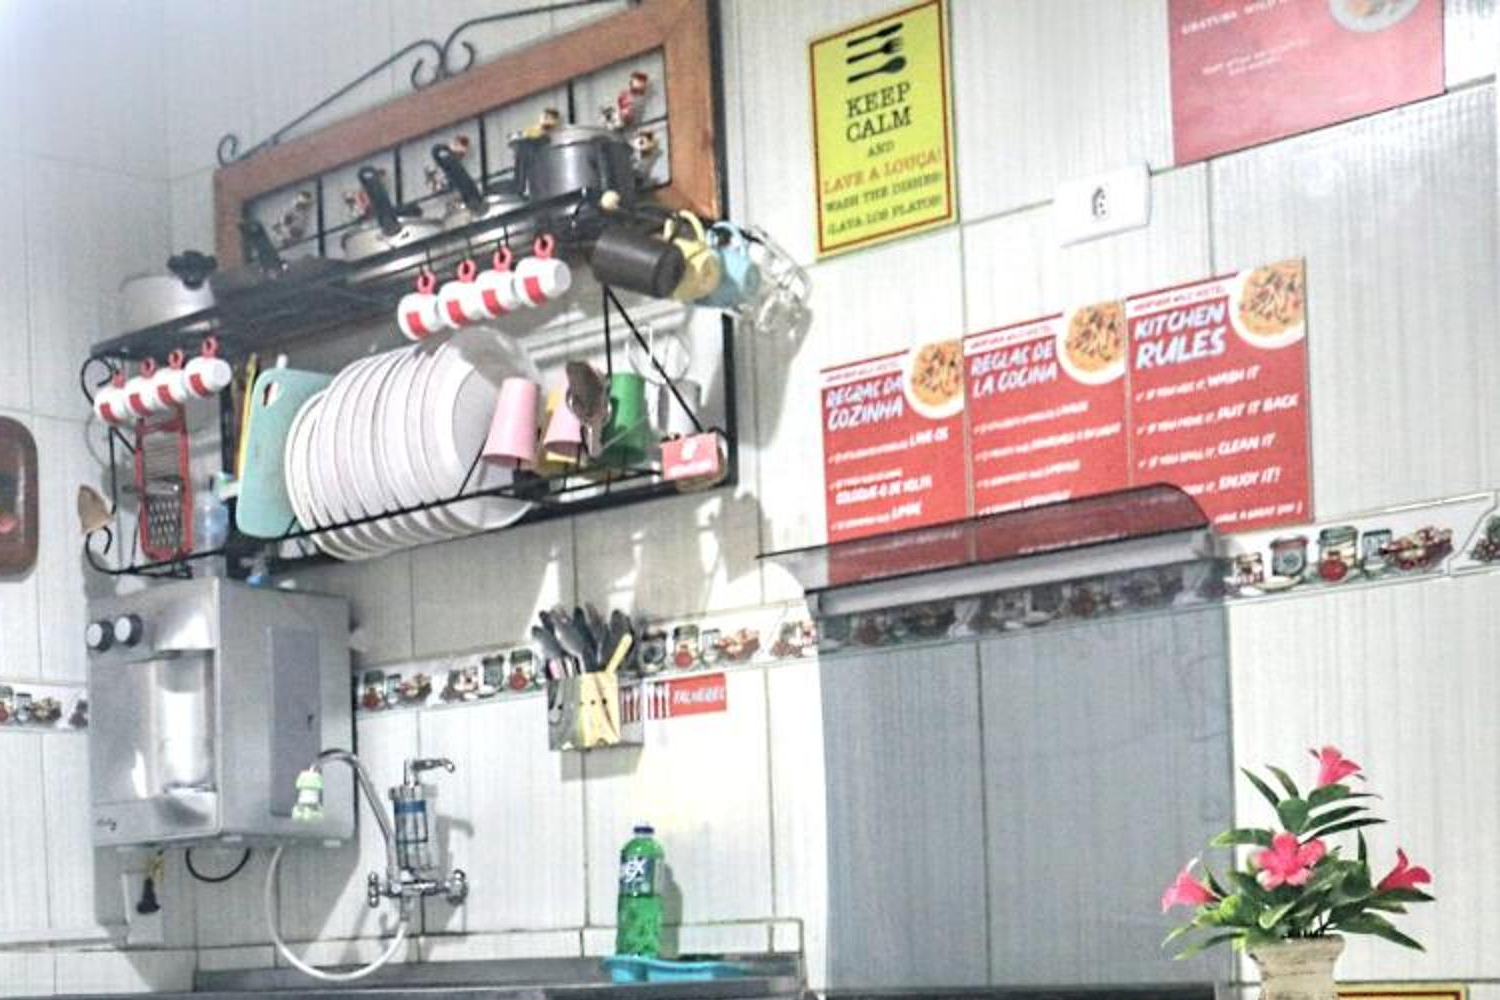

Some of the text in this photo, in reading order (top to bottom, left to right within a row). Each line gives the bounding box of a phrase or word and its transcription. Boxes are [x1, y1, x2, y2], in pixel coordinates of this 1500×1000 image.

[846, 81, 911, 118] KEEP
[846, 105, 912, 142] CALM
[868, 141, 895, 157] AND
[824, 170, 865, 194] LAVE
[869, 166, 880, 180] A
[825, 195, 859, 212] WASH
[863, 187, 888, 202] THE
[866, 208, 889, 223] LOS
[1135, 302, 1226, 341] KITCHEN
[1032, 339, 1054, 361] DE
[1136, 326, 1227, 370] RULES
[882, 375, 904, 396] DA
[973, 361, 1058, 400] LA COCINA
[1207, 369, 1245, 388] WASH
[1247, 365, 1261, 380] IT
[827, 395, 904, 432] COZINHA
[1217, 402, 1245, 421] PUT
[1247, 400, 1261, 415] IT
[1262, 393, 1299, 413] BACK
[1217, 436, 1259, 455] CLEAN
[1261, 432, 1276, 447] IT
[1219, 471, 1260, 490] ENJOY
